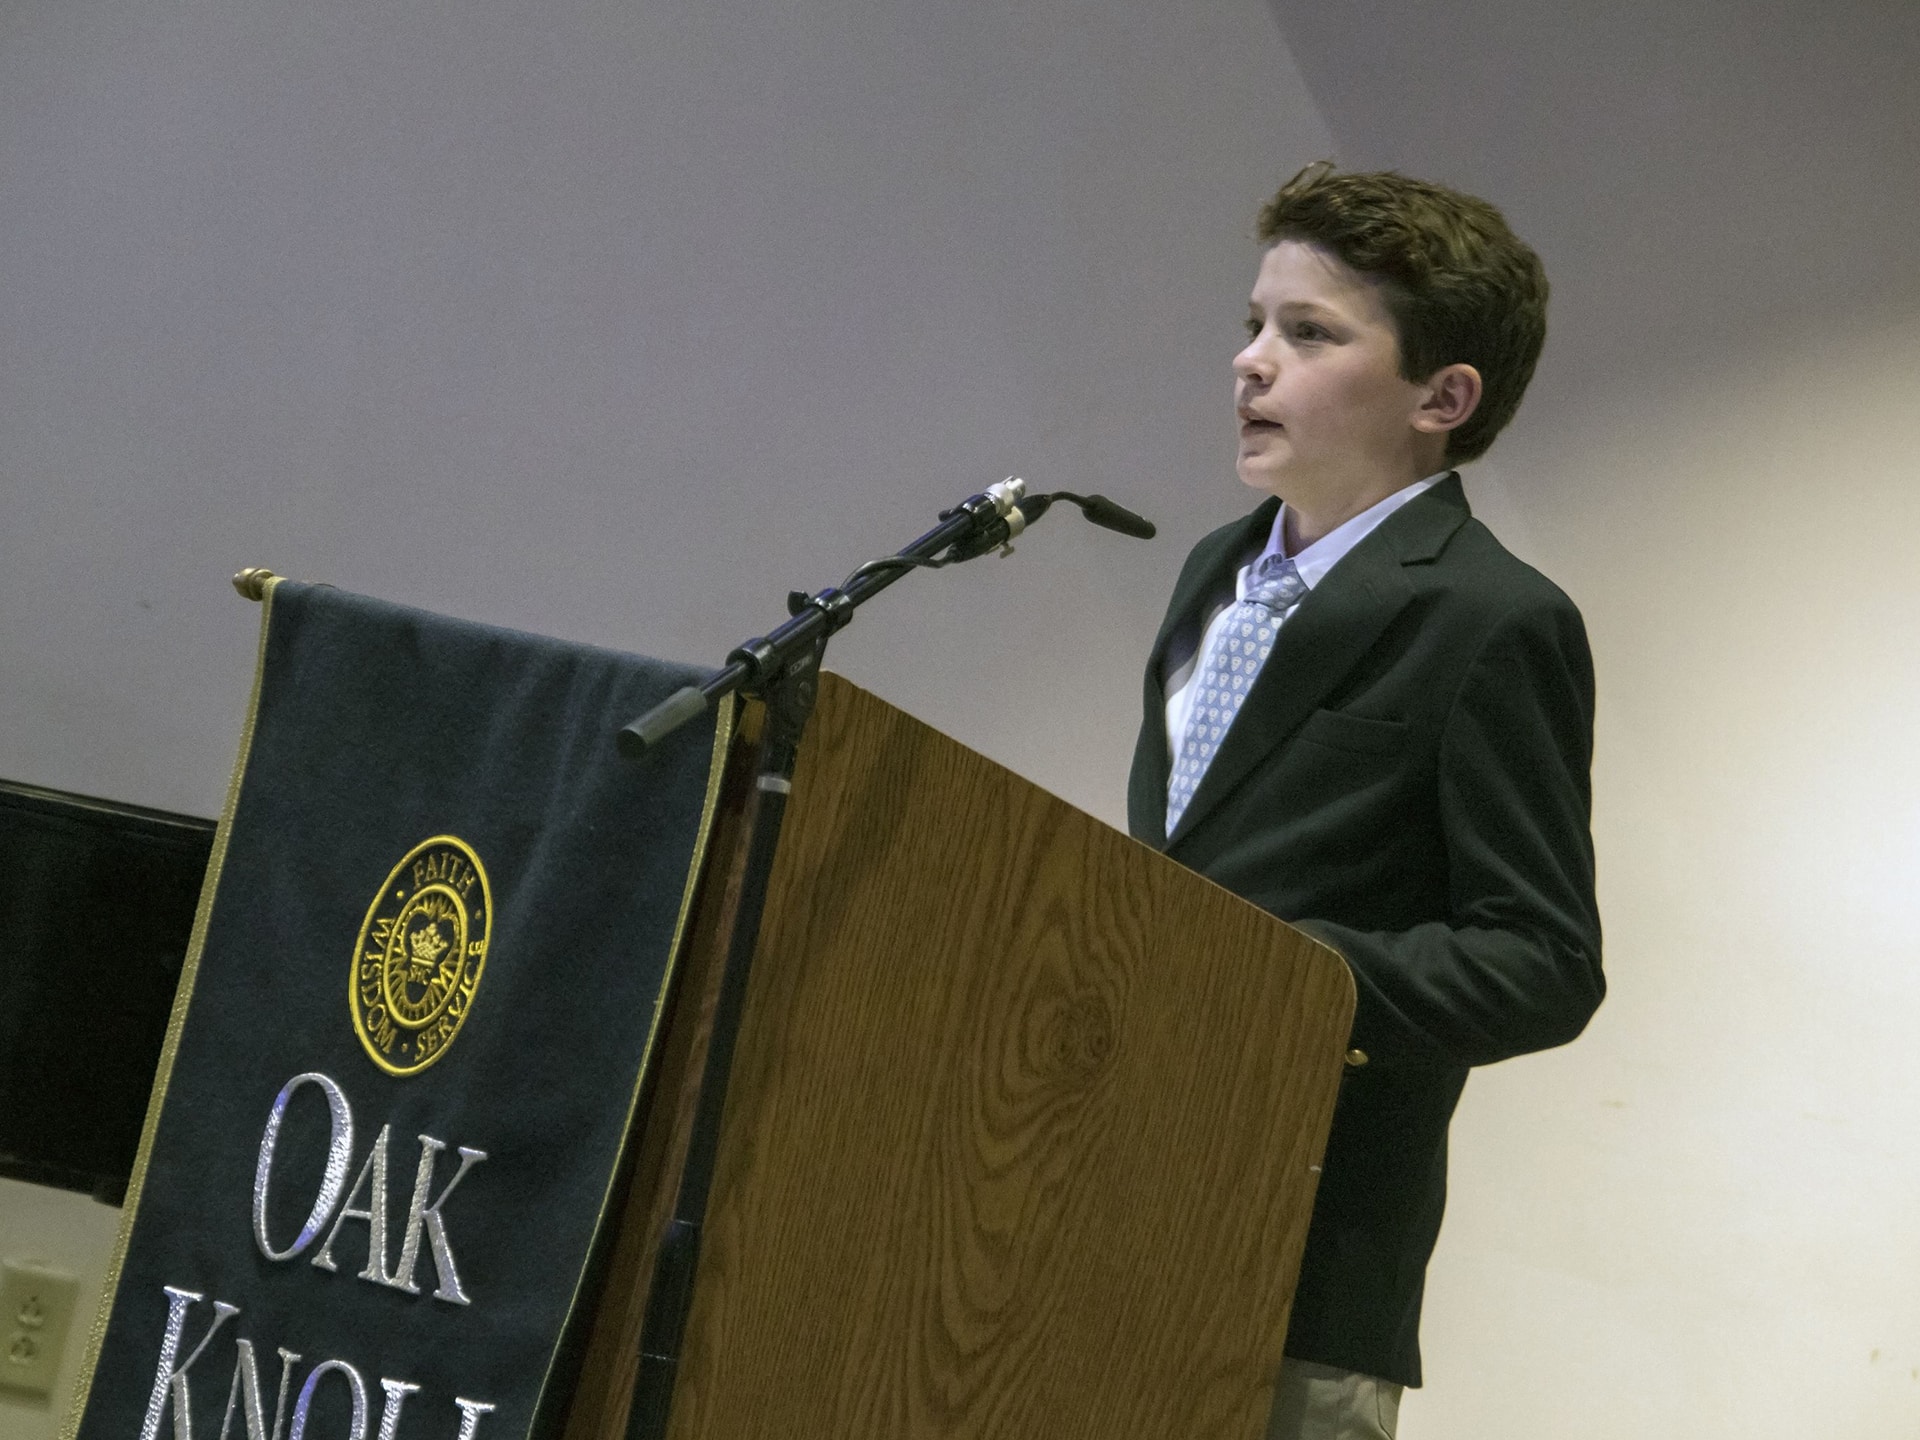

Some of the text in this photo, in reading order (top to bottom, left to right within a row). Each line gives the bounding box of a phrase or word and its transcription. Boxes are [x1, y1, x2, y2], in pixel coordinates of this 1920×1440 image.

[412, 852, 476, 899] FAITH
[361, 917, 398, 1054] WISDOM
[414, 939, 485, 1062] SERVICE
[252, 1072, 488, 1305] OAK
[138, 1285, 495, 1440] KNO
